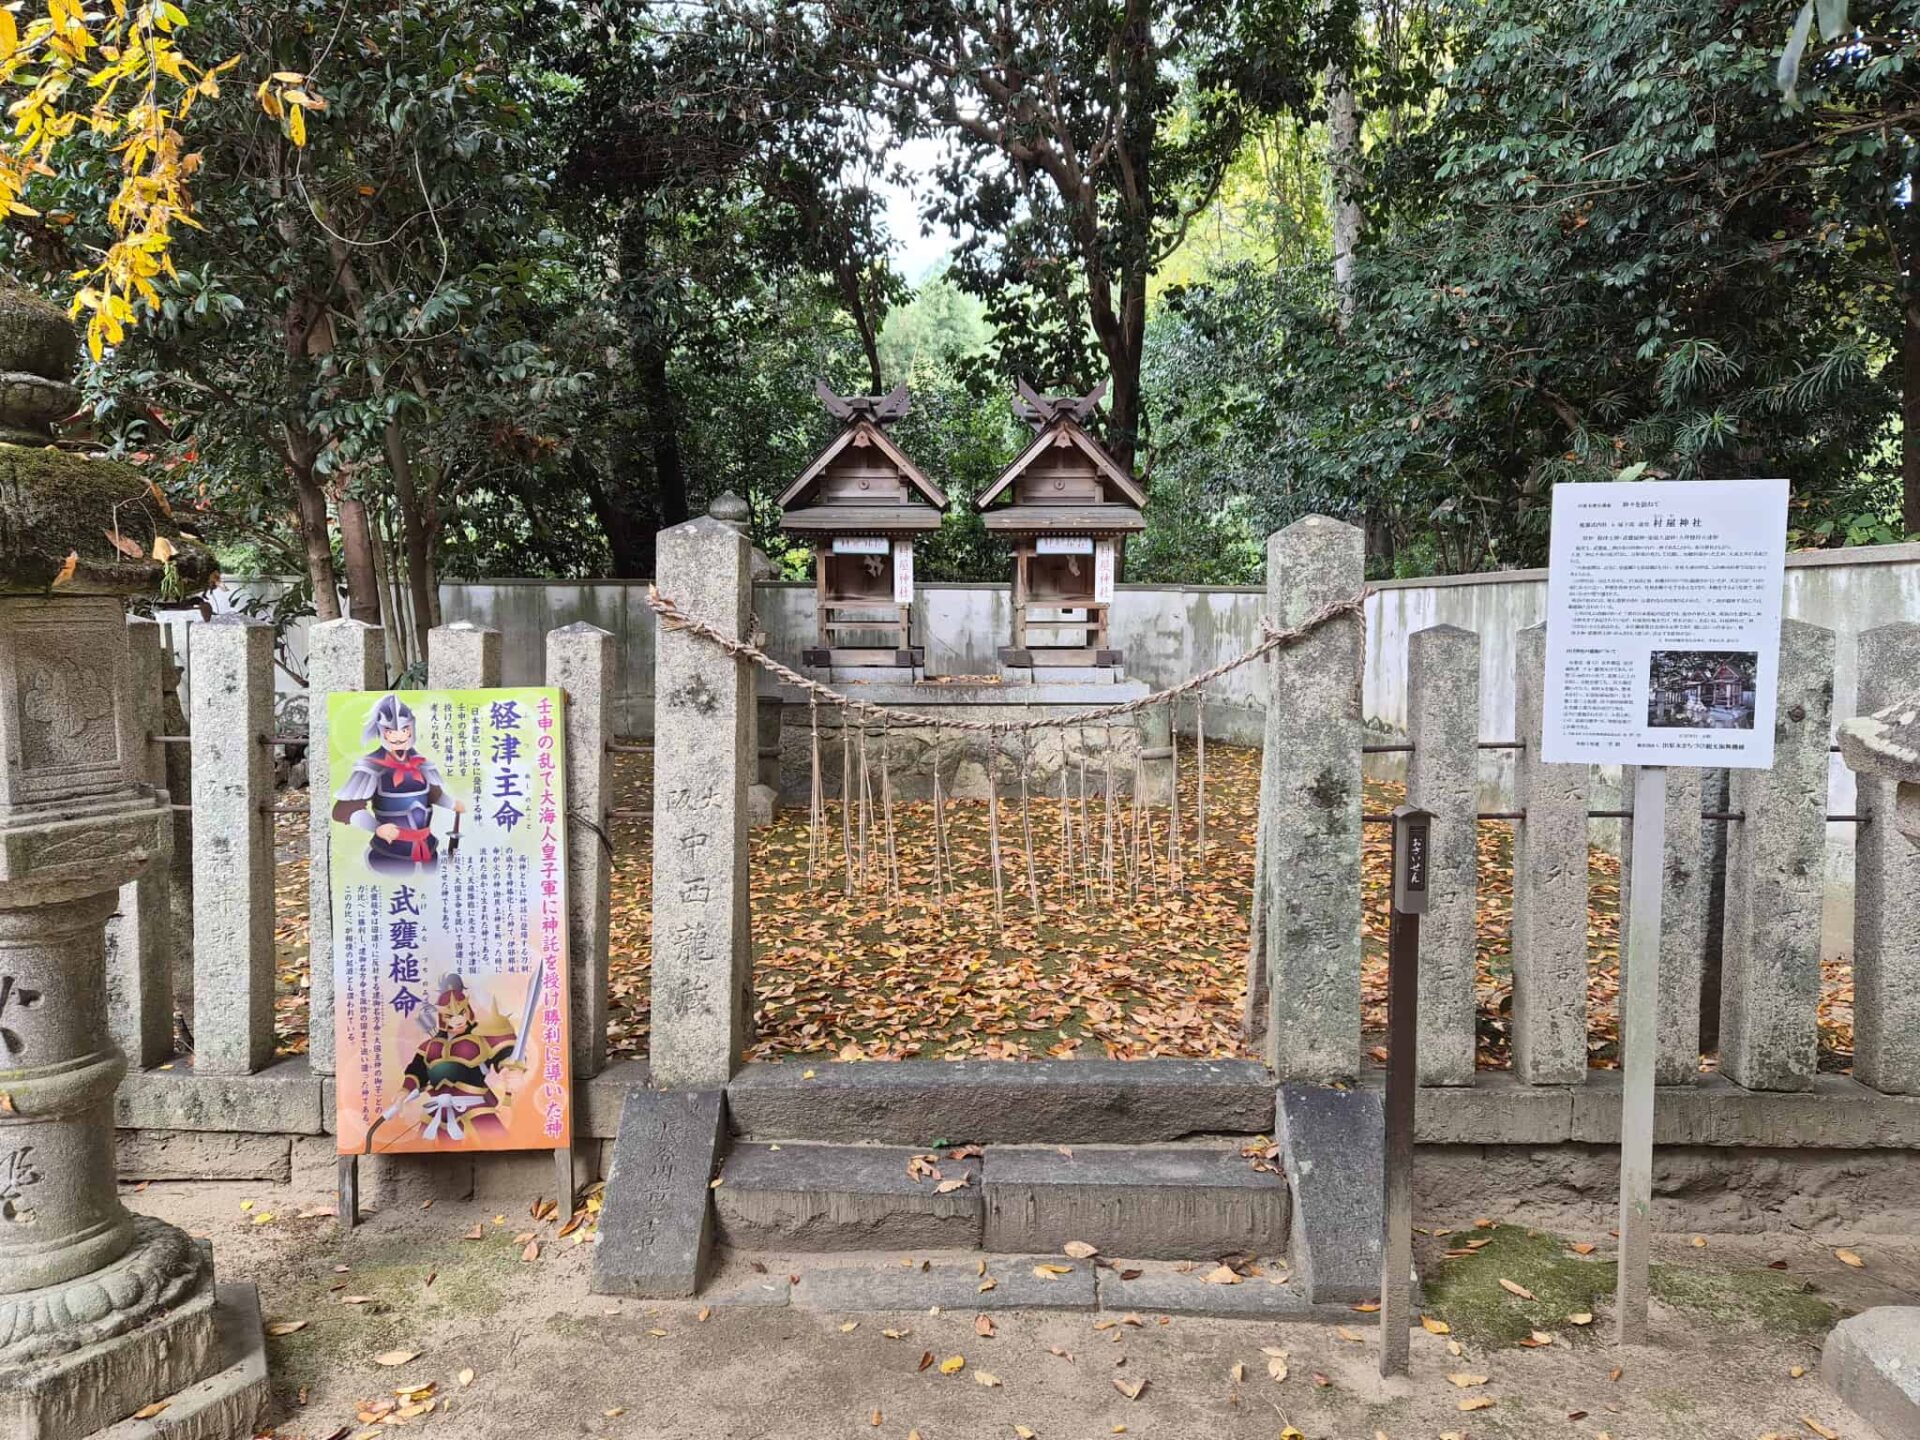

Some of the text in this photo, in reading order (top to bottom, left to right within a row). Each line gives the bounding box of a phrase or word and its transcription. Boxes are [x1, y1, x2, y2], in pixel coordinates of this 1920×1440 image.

[1653, 517, 1702, 528] 村屋神社
[490, 700, 524, 833] 経津主命
[536, 697, 563, 1137] 壬申の乱で大海人皇子軍に神託を授け勝利に導いた神
[1410, 838, 1422, 884] おさいせん
[388, 884, 422, 1019] 武甕槌命
